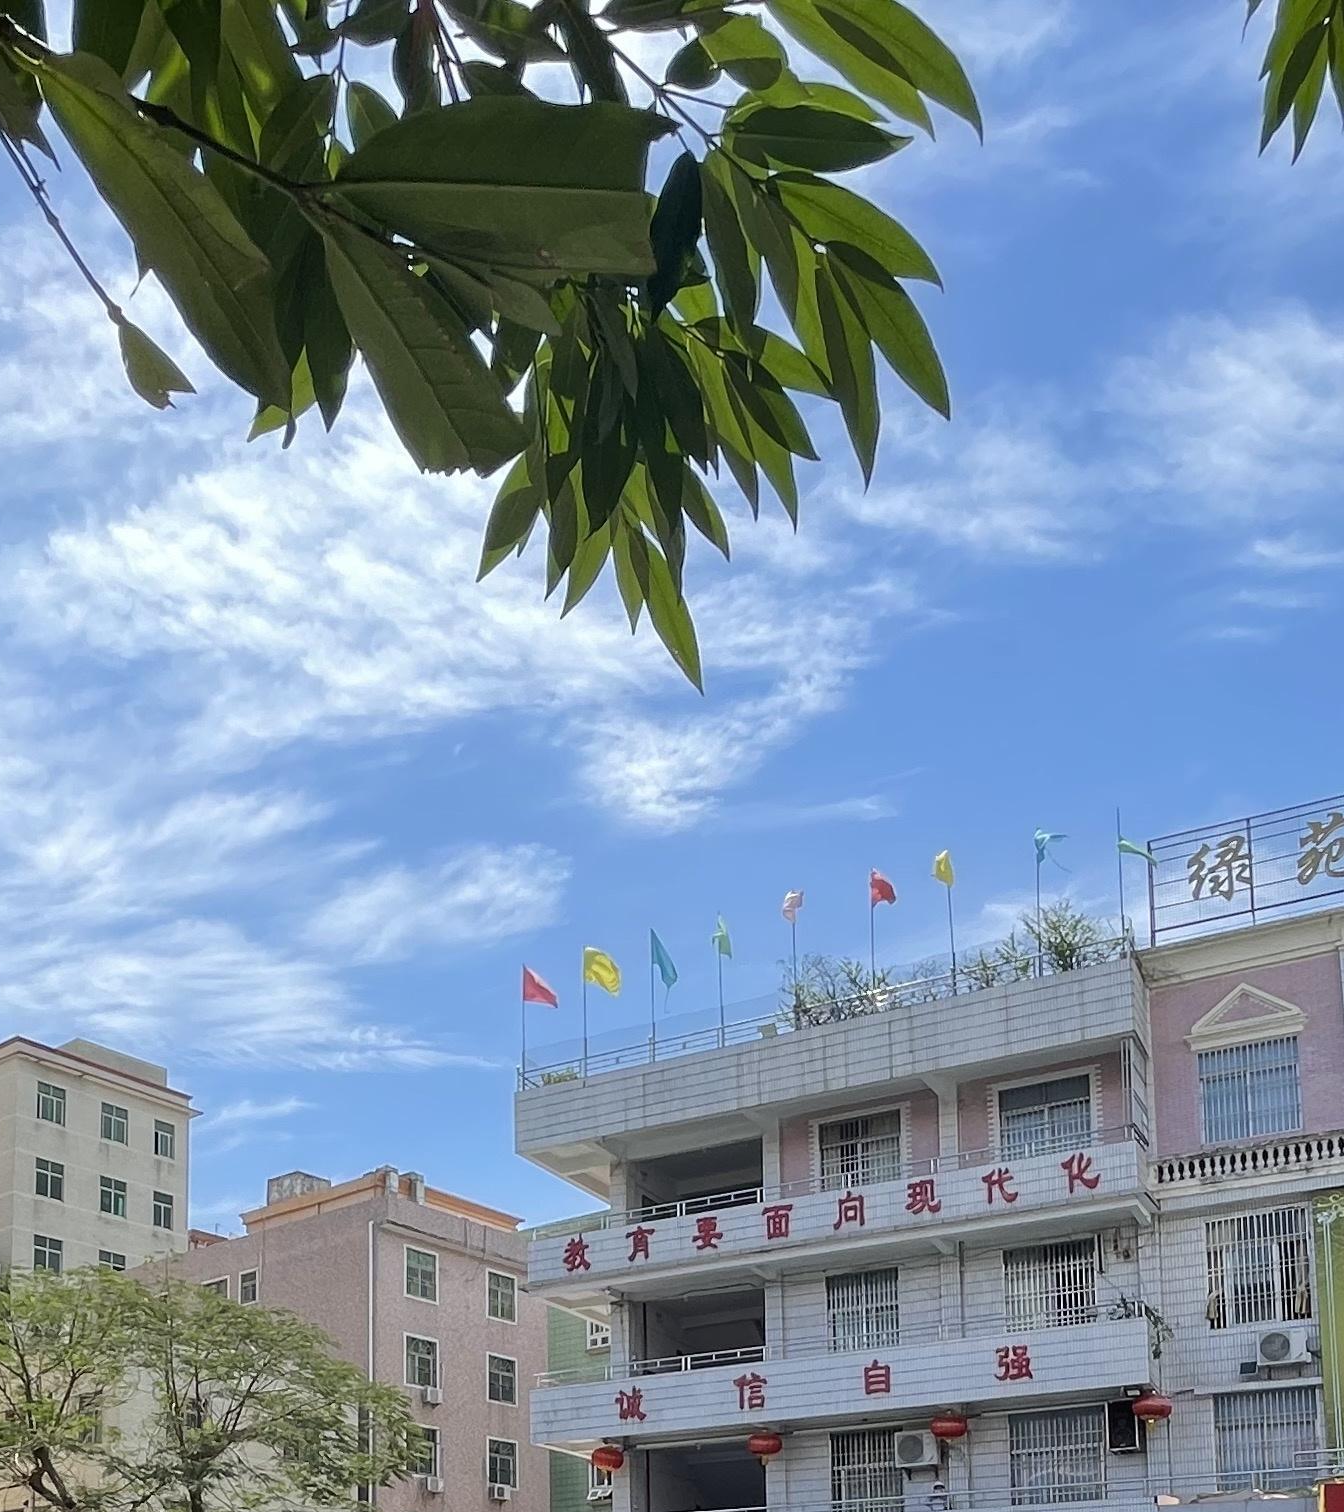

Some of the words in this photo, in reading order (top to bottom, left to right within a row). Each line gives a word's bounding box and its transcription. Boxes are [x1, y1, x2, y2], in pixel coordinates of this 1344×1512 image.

[563, 1152, 1101, 1272] 教育要面向现代化
[615, 1345, 1034, 1422] 诚信自强
